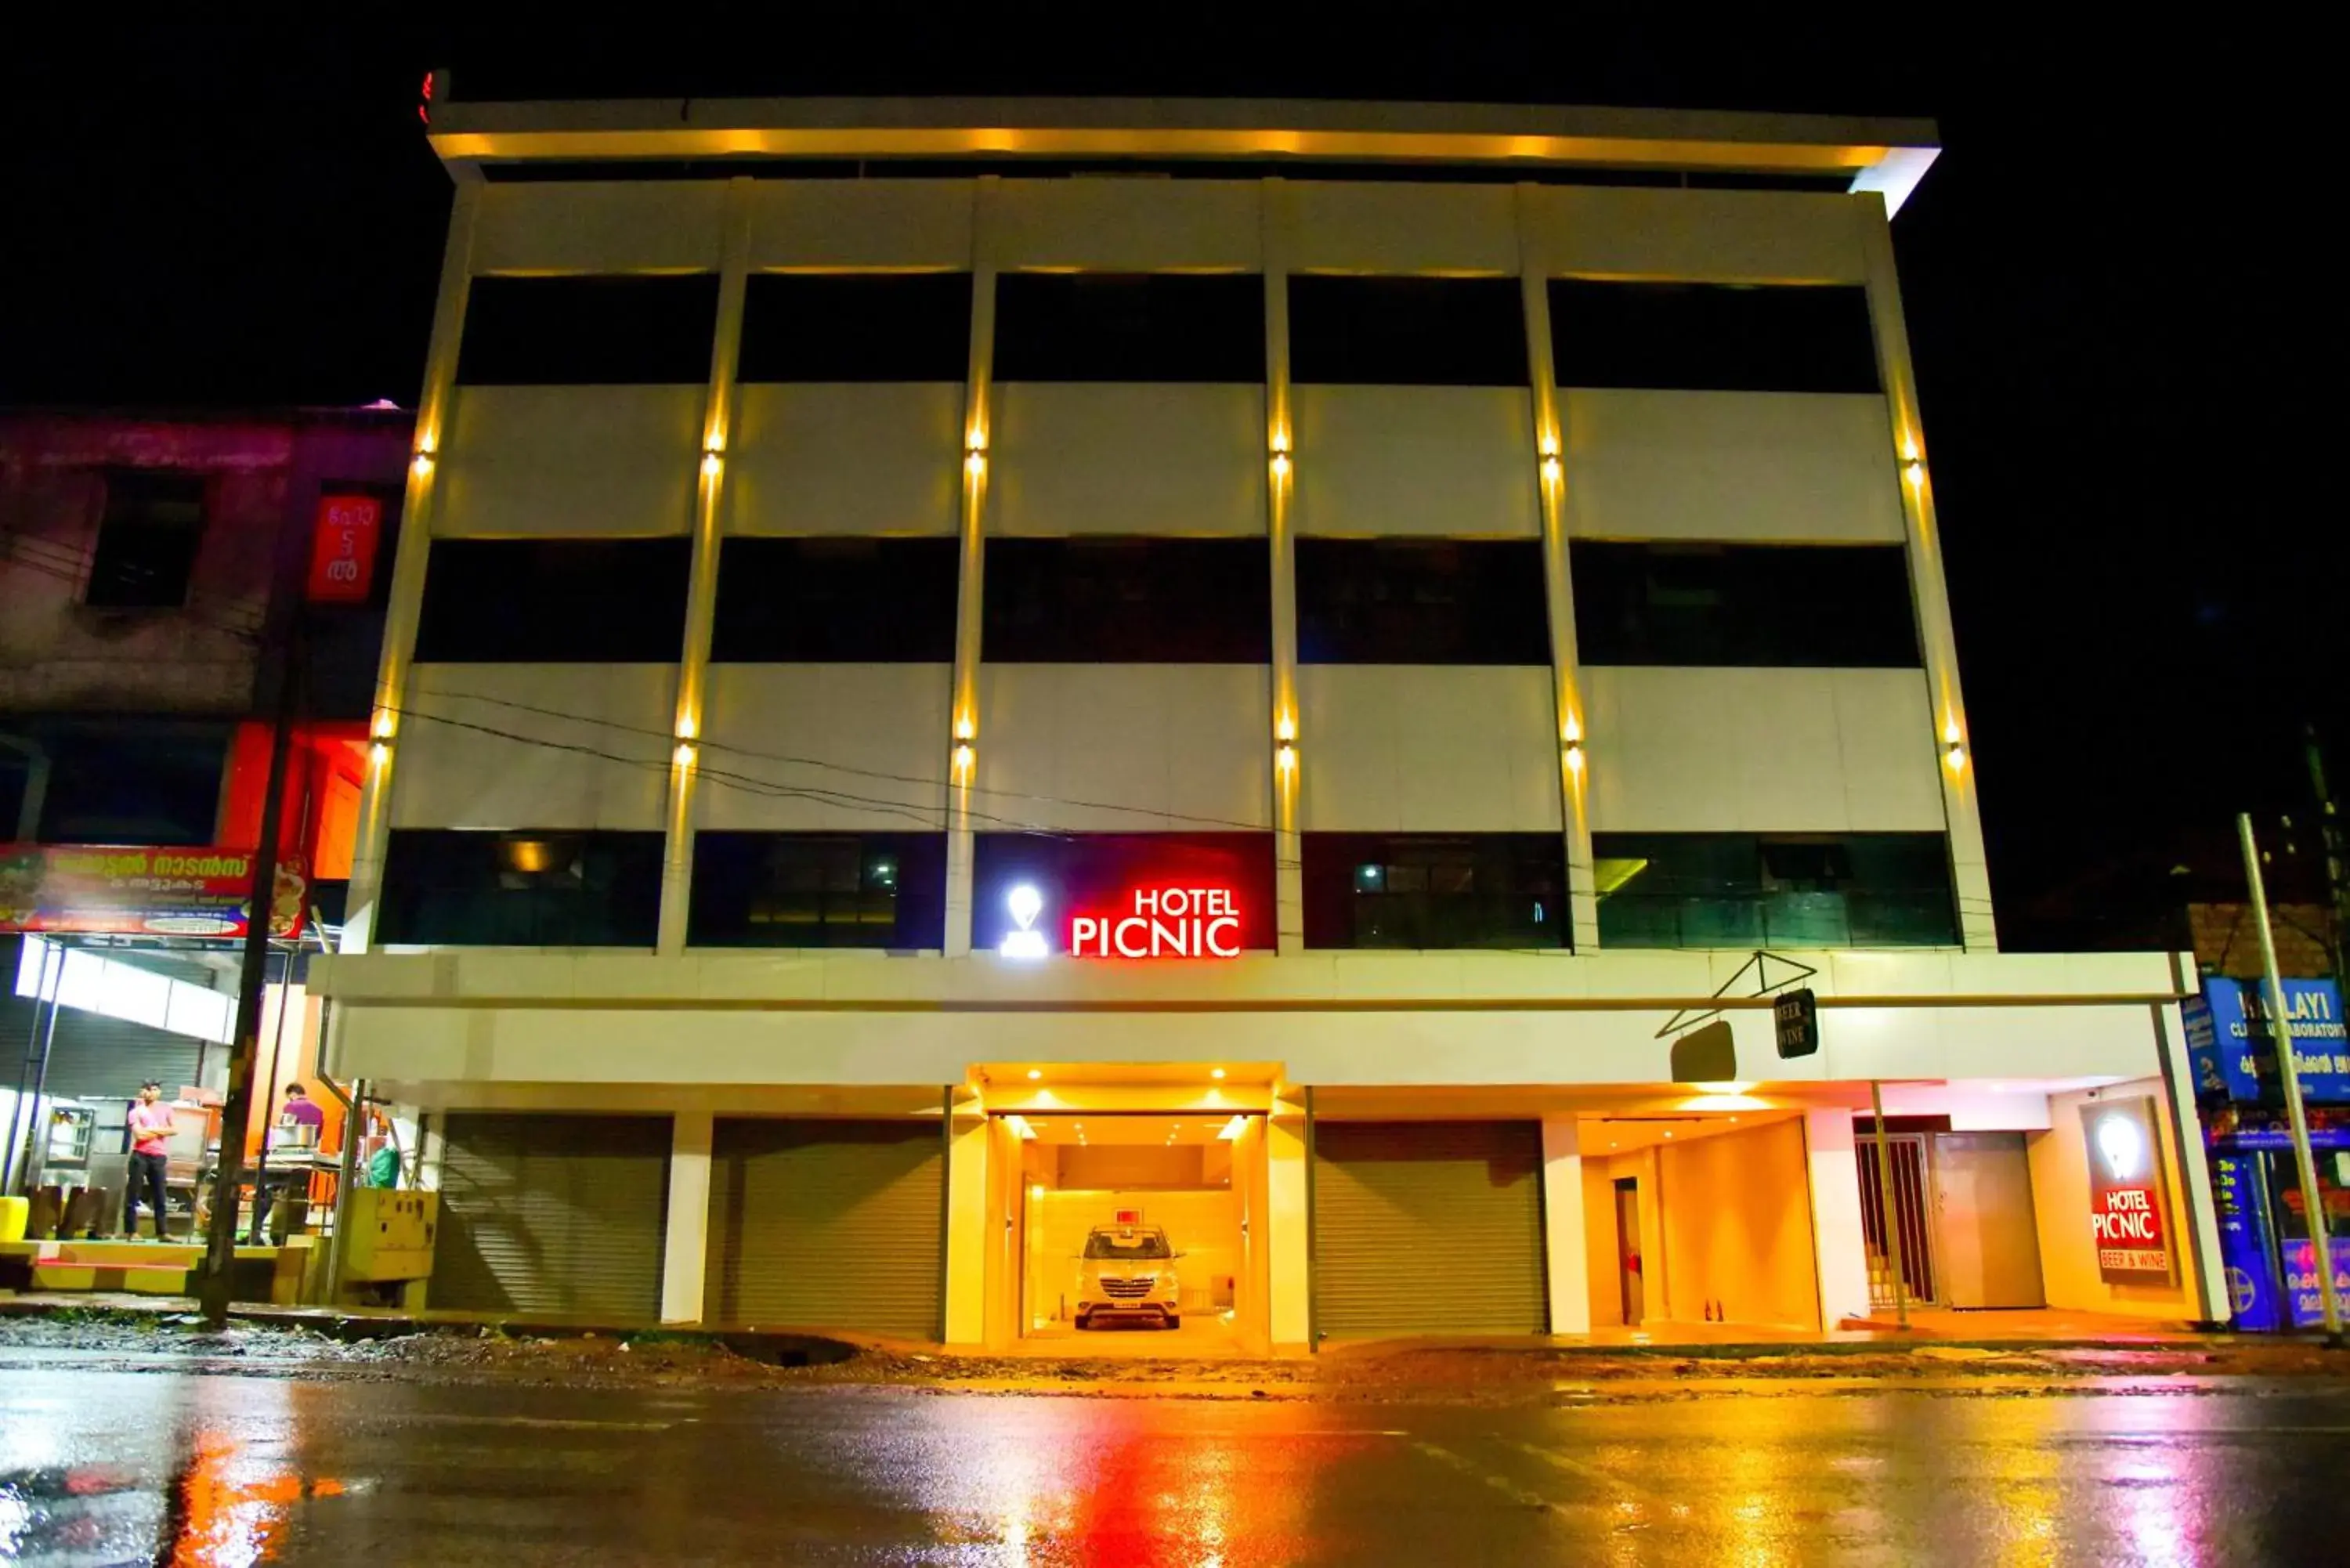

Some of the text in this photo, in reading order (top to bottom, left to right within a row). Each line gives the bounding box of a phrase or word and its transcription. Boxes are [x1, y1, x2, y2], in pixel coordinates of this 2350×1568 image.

[1135, 888, 1239, 916] HOTEL
[1072, 917, 1241, 958] PICNIC
[2106, 1190, 2150, 1211] HOTEL
[2092, 1212, 2155, 1239] PICNIC
[2102, 1252, 2124, 1266] BEER
[2138, 1252, 2166, 1269] WINE
